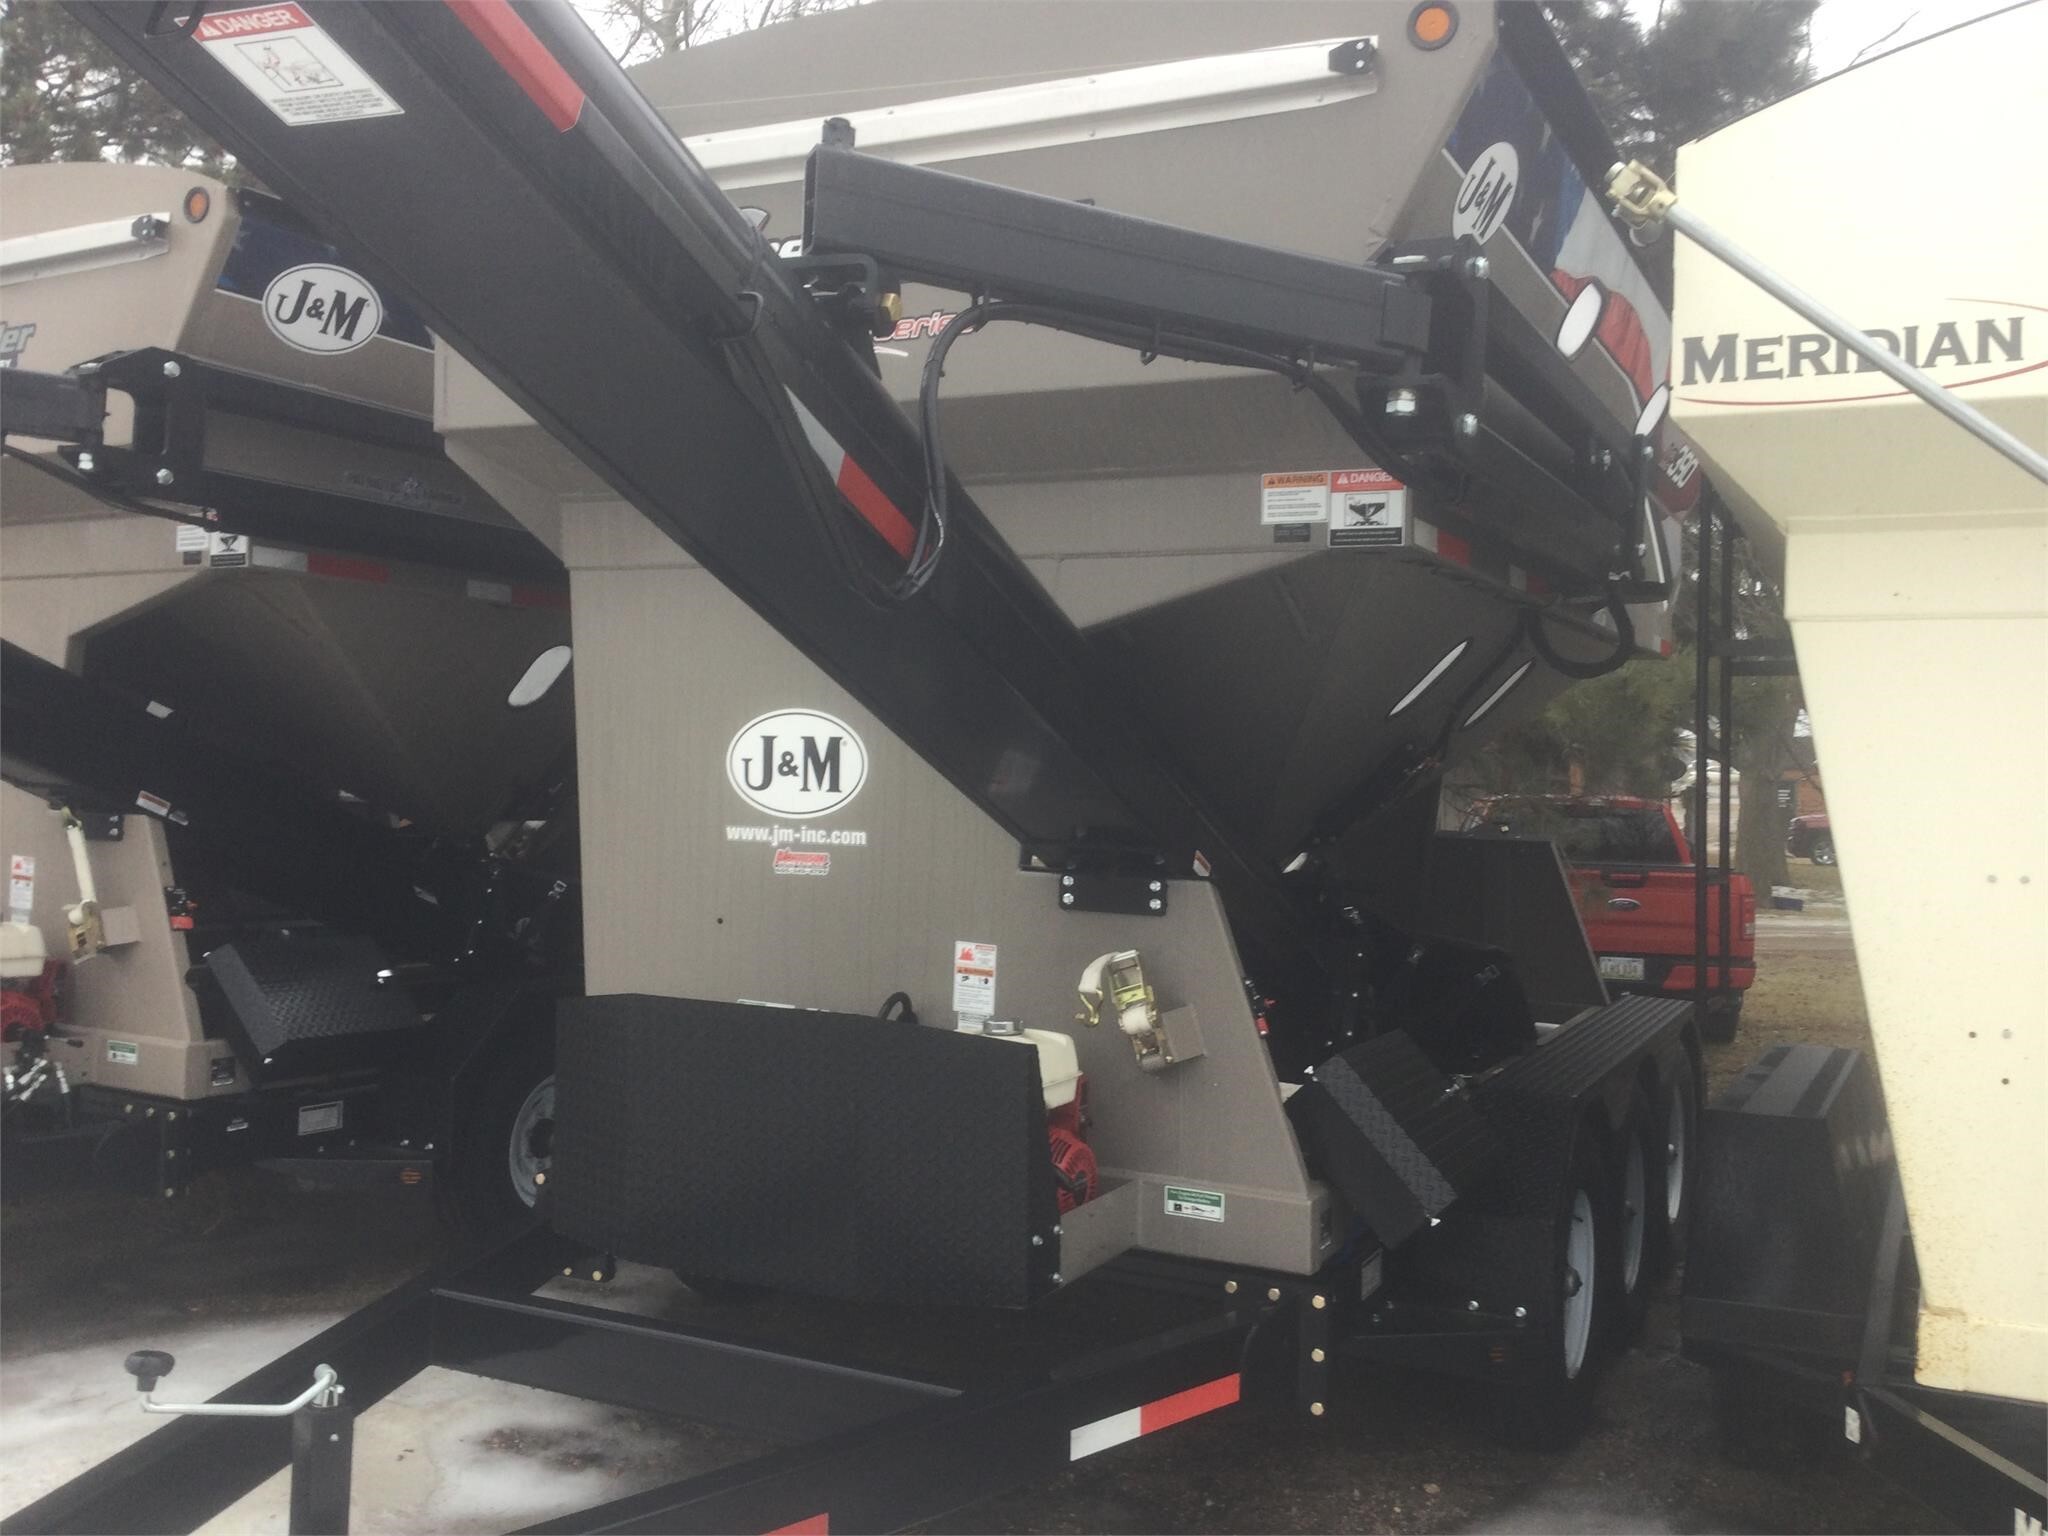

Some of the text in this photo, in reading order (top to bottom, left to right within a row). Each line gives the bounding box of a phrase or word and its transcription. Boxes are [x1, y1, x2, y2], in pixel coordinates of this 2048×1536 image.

[215, 9, 299, 35] DANGER
[1458, 156, 1513, 238] J&M
[275, 279, 369, 342] J&M
[1682, 317, 2024, 386] MERIDIAN
[1277, 474, 1325, 485] WARNING
[1350, 471, 1394, 484] DANGE
[741, 735, 843, 793] J&M
[725, 824, 867, 847] www.jm-inc.com
